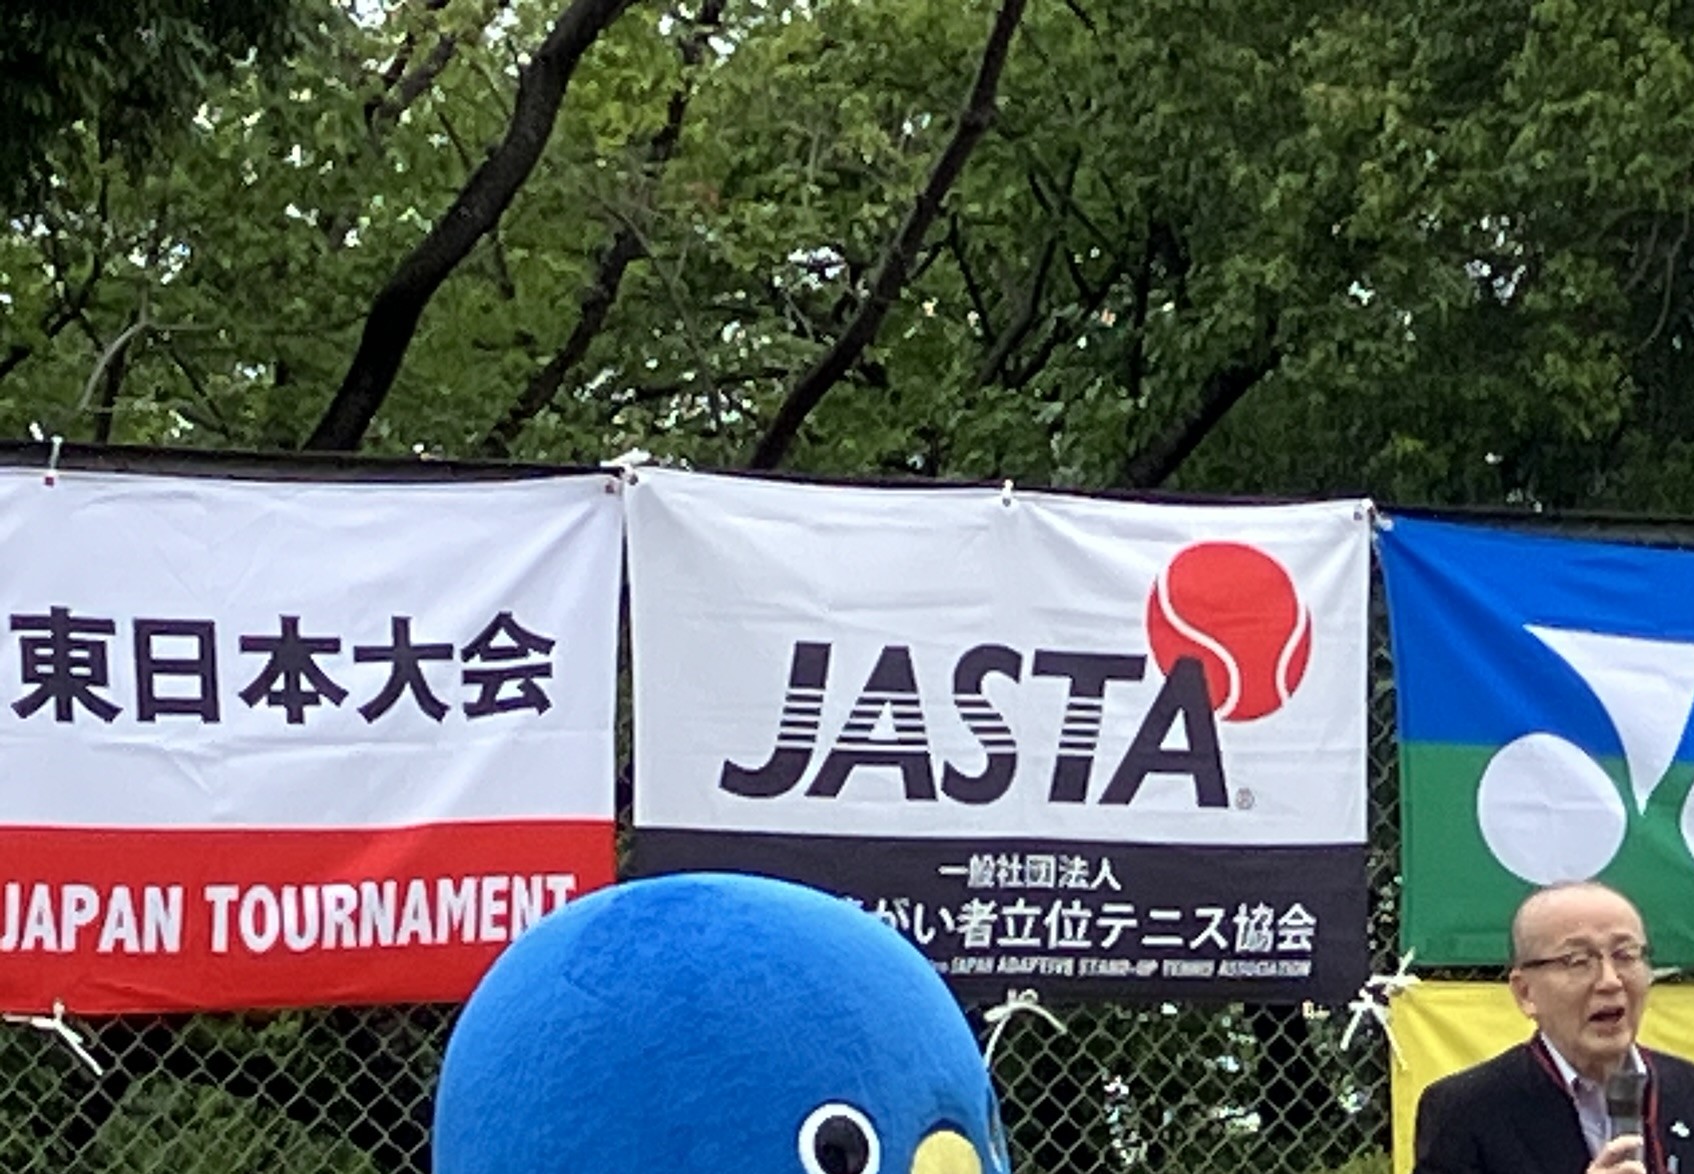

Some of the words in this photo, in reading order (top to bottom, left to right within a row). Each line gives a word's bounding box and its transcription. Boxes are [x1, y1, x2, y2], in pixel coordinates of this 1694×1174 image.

[10, 606, 557, 724] 東日本大会
[717, 640, 1229, 809] JASTA
[938, 853, 1122, 891] 一般社団法人
[0, 882, 183, 953] JAPAN
[204, 873, 577, 953] TOURNAMENT
[846, 897, 1317, 953] がい者立位テニス協会
